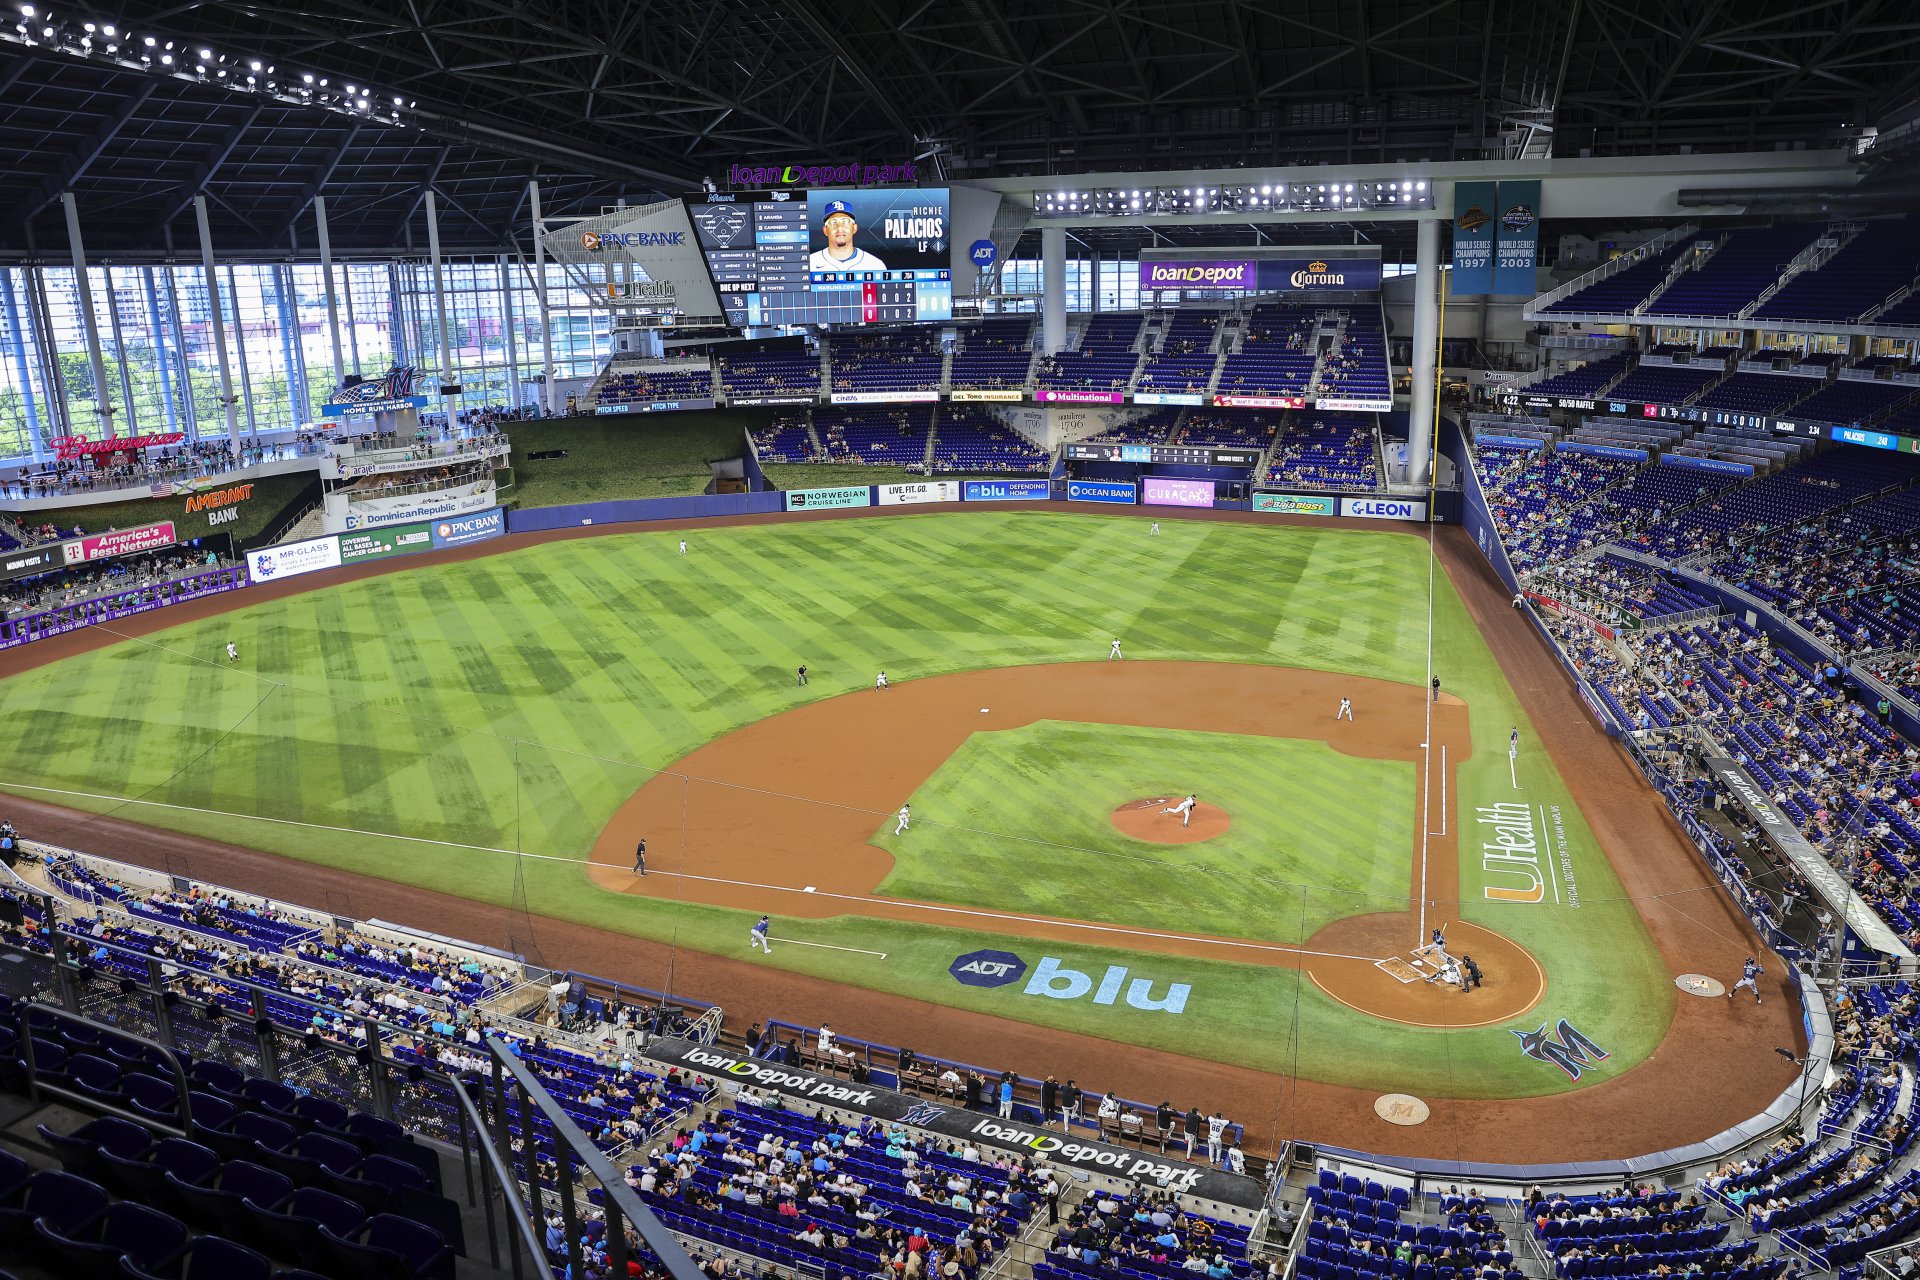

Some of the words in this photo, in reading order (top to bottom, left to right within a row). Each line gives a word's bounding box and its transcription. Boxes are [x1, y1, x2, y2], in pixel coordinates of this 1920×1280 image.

[731, 162, 861, 186] loanDepot
[863, 161, 917, 185] park
[913, 207, 943, 216] RICHIE
[885, 218, 943, 239] PALACIOS
[602, 232, 636, 246] PNC
[639, 231, 683, 246] BANK
[1455, 241, 1472, 249] WORLD
[1473, 240, 1491, 249] SERIES
[1498, 241, 1516, 249] WORLD
[1516, 240, 1535, 249] SERIES
[918, 241, 928, 253] LF
[972, 247, 994, 258] ADT
[1498, 249, 1534, 258] CHAMPIONS
[1455, 250, 1490, 258] CHAMPIONS
[1459, 259, 1486, 268] 1997
[1500, 259, 1531, 268] 2003
[1151, 265, 1244, 284] loanDepot
[1290, 270, 1345, 289] Corona
[608, 280, 675, 298] UHealth
[720, 283, 731, 291] DUE
[731, 283, 740, 291] UP
[740, 283, 755, 291] NEXT
[732, 296, 743, 307] TB
[763, 296, 768, 306] 0
[867, 293, 872, 303] 0
[882, 293, 887, 303] 0
[895, 292, 900, 302] 0
[906, 292, 911, 302] 2
[921, 297, 927, 311] 0
[931, 296, 938, 311] 0
[942, 296, 949, 310] 0
[661, 314, 672, 323] 42
[763, 312, 768, 322] 0
[868, 309, 873, 319] 0
[895, 309, 900, 318] 0
[907, 309, 911, 318] 2
[361, 387, 375, 395] NCL
[1057, 392, 1112, 402] Multinational
[343, 407, 366, 415] HOME
[368, 405, 384, 413] RUN
[386, 402, 413, 411] HARBOR
[651, 402, 666, 410] PITCH
[1503, 395, 1518, 406] 4:22
[1558, 399, 1575, 409] 50/50
[1575, 400, 1595, 410] RAFFLE
[1650, 406, 1655, 415] 2
[1661, 407, 1666, 416] 0
[1702, 411, 1708, 421] 0
[1724, 414, 1729, 424] 0
[1732, 415, 1738, 425] S
[1740, 415, 1745, 426] 0
[1755, 417, 1760, 428] 0
[1061, 419, 1084, 431] 1796
[1808, 425, 1820, 436] 3.34
[1843, 430, 1866, 442] PALACIOS
[50, 431, 187, 461] Budweiser
[353, 464, 376, 476] arajet
[416, 460, 437, 468] PARTNER
[807, 490, 866, 500] NORWEGIAN
[889, 486, 905, 495] LIVE.
[981, 485, 1005, 497] blu
[1081, 487, 1109, 497] OCEAN
[1110, 488, 1133, 498] BANK
[185, 484, 255, 513] AMERANT
[1273, 501, 1295, 511] Baja
[1295, 502, 1324, 511] Blast
[1365, 502, 1411, 517] LEON
[208, 506, 239, 526] BANK
[451, 519, 475, 534] PNC
[475, 514, 501, 529] BANK
[99, 528, 160, 547] America's
[341, 535, 371, 546] COVERING
[67, 545, 80, 559] T
[90, 543, 122, 558] Best
[123, 535, 171, 553] Network
[343, 550, 366, 558] CANCER
[366, 546, 383, 554] CARE
[354, 542, 373, 551] BASES
[45, 551, 50, 563] 4
[281, 559, 299, 567] DOORS
[304, 553, 330, 562] WINDOWS
[285, 558, 327, 571] MANUFACTURING
[178, 585, 230, 602] WernerHoffman.com
[114, 609, 131, 618] Injury
[132, 603, 155, 614] Lawyers
[1721, 769, 1751, 789] park
[1550, 805, 1562, 825] MARLINS
[1554, 825, 1565, 840] MIAMI
[1557, 840, 1567, 850] THE
[1476, 803, 1545, 903] UHealth
[1559, 850, 1570, 858] OF
[1560, 858, 1575, 882] DOCTORS
[1566, 883, 1581, 909] OFFICIAL
[958, 960, 1016, 977] ADT
[1023, 956, 1192, 1014] blu
[681, 1047, 817, 1091] loanDepot
[807, 1081, 877, 1107] park
[971, 1119, 1132, 1170] loanDepot
[1125, 1157, 1205, 1188] park
